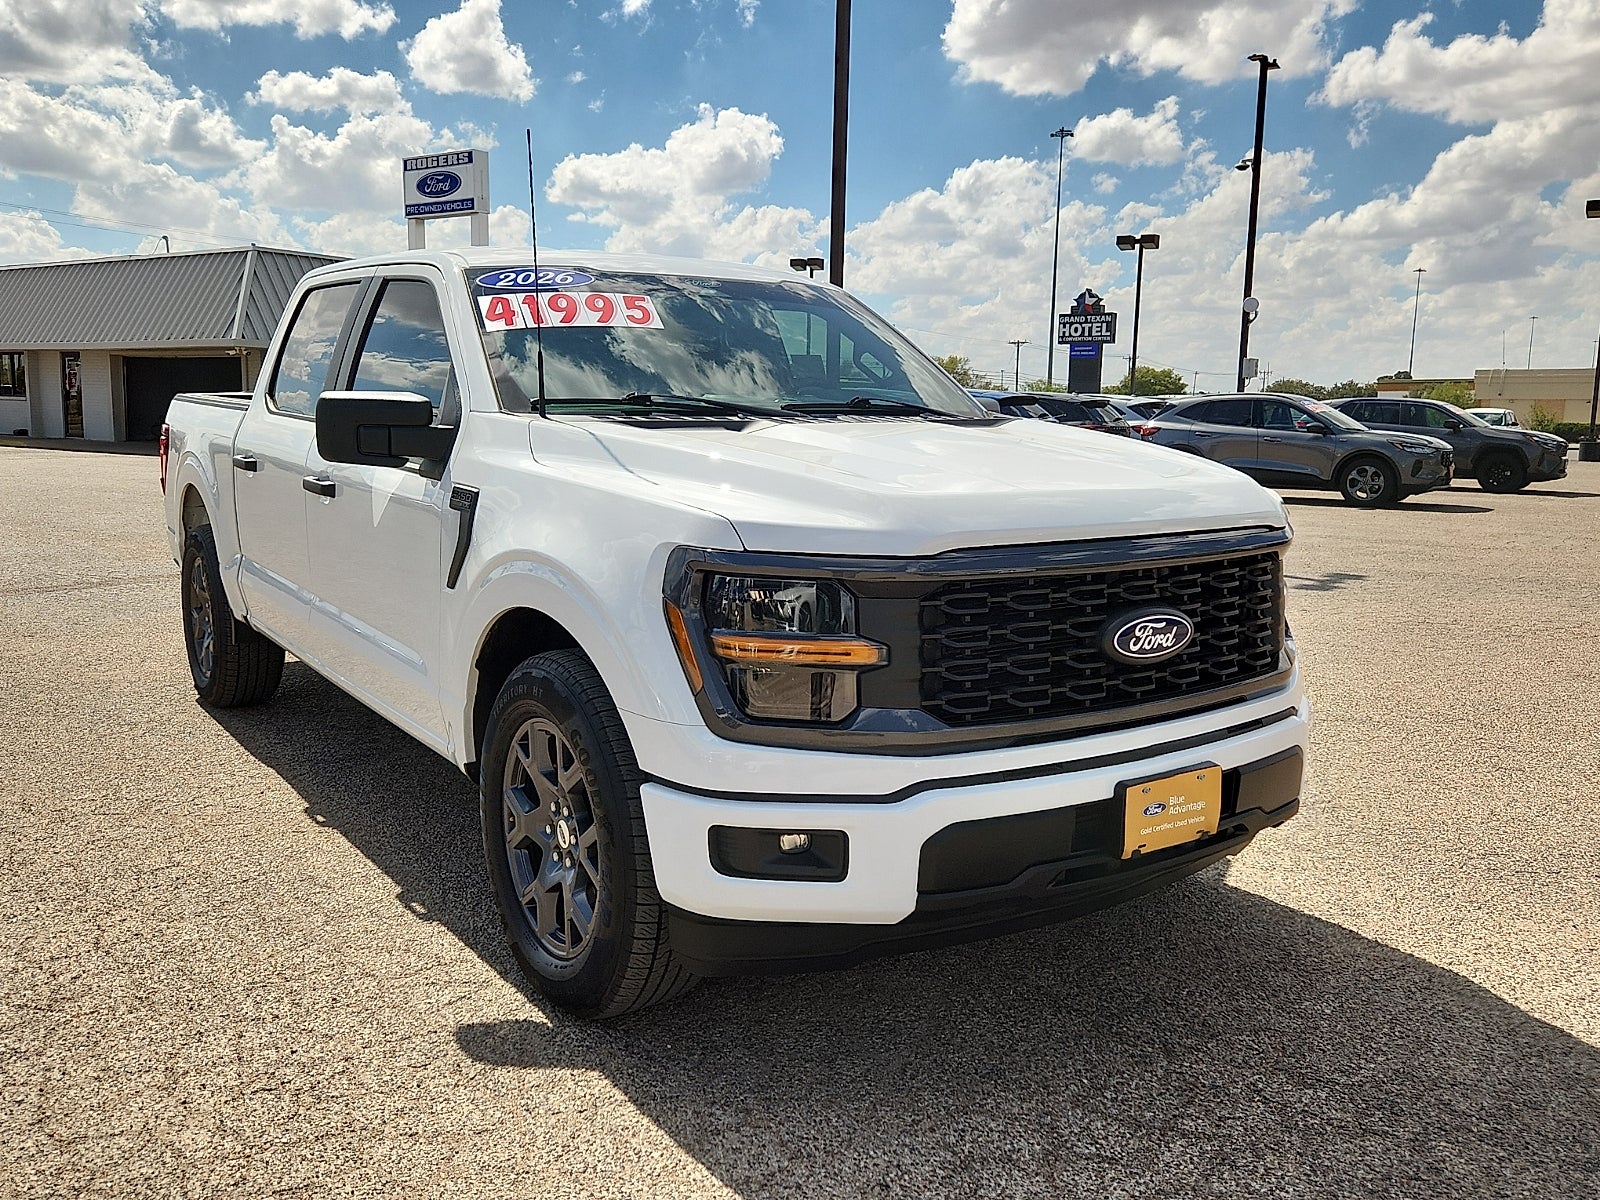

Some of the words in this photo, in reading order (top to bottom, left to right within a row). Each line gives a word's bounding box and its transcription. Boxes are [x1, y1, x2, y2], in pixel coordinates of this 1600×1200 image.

[406, 152, 469, 171] ROGERS
[424, 175, 451, 193] Ford
[406, 202, 443, 214] PRE-OWNED
[443, 200, 473, 210] VEHICLES
[495, 271, 576, 286] 2026
[485, 293, 652, 326] 41995
[1059, 315, 1085, 323] GRAND
[1058, 323, 1110, 336] HOTEL
[1129, 621, 1178, 652] Ford
[1169, 795, 1185, 806] Blue
[1169, 800, 1206, 815] Advantage
[1140, 826, 1152, 835] Gold
[1153, 822, 1174, 832] Certified
[1174, 819, 1188, 828] Used
[1188, 815, 1206, 824] Vehicle
